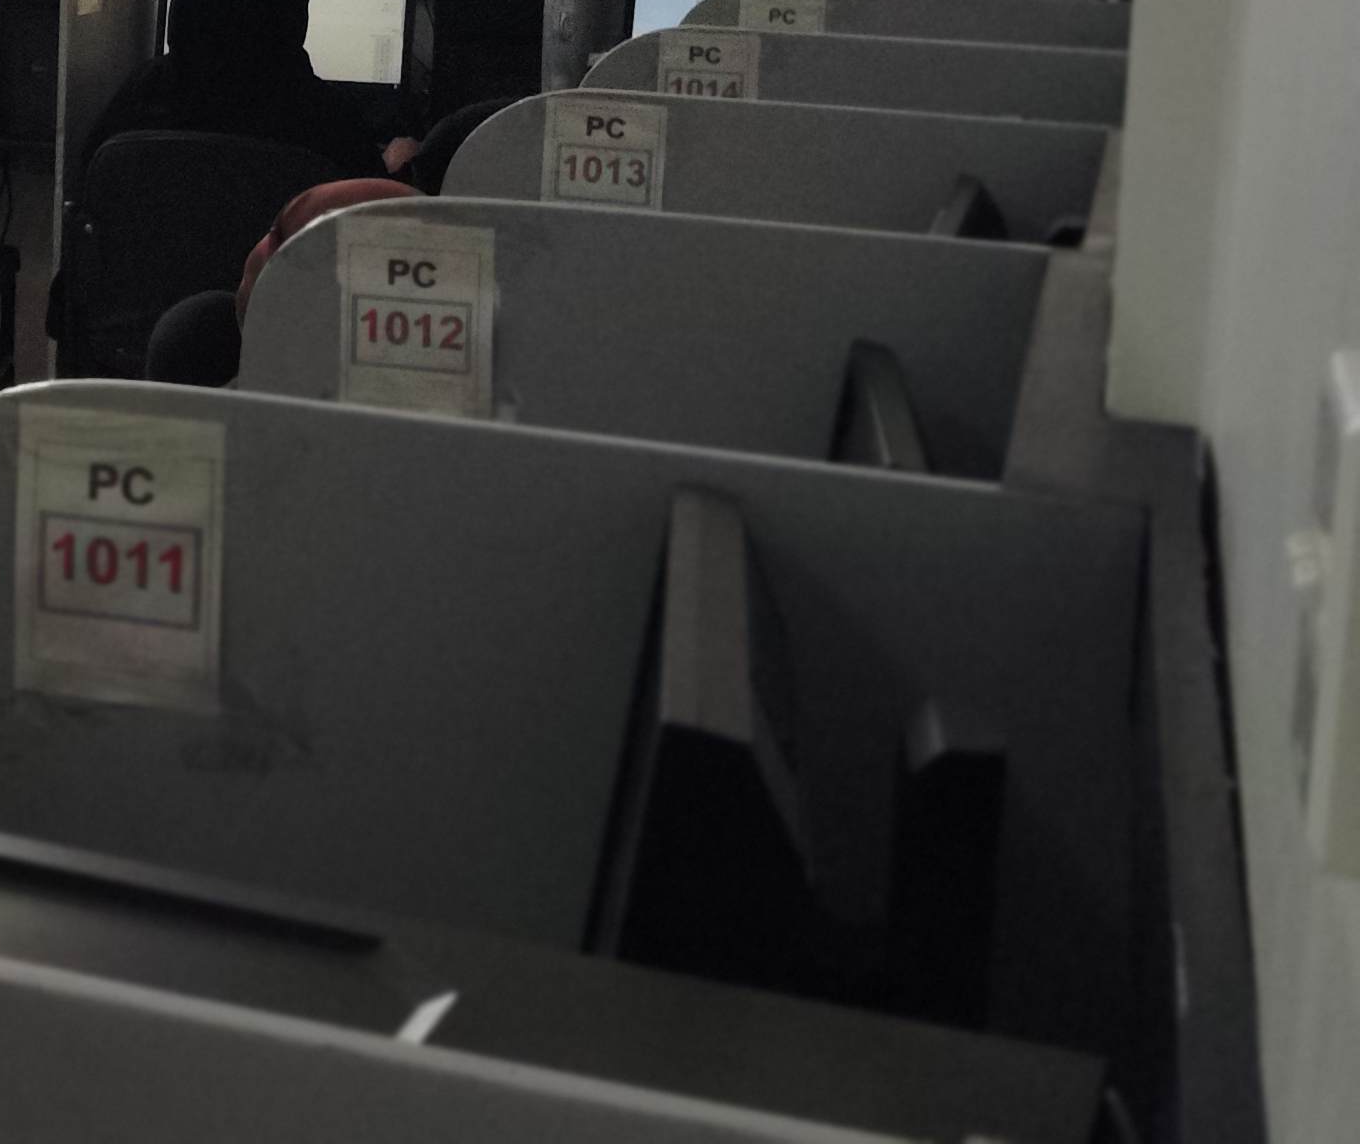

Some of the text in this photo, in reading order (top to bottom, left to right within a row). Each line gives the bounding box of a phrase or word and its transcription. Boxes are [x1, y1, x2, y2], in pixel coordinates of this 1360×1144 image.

[768, 8, 796, 25] PC
[689, 46, 721, 64] PC
[670, 76, 742, 98] 1014
[586, 116, 626, 139] PC
[564, 154, 646, 187] 1013
[388, 259, 437, 288] PC
[360, 308, 464, 351] 1012
[88, 462, 155, 505] PC
[52, 532, 184, 594] 1011
